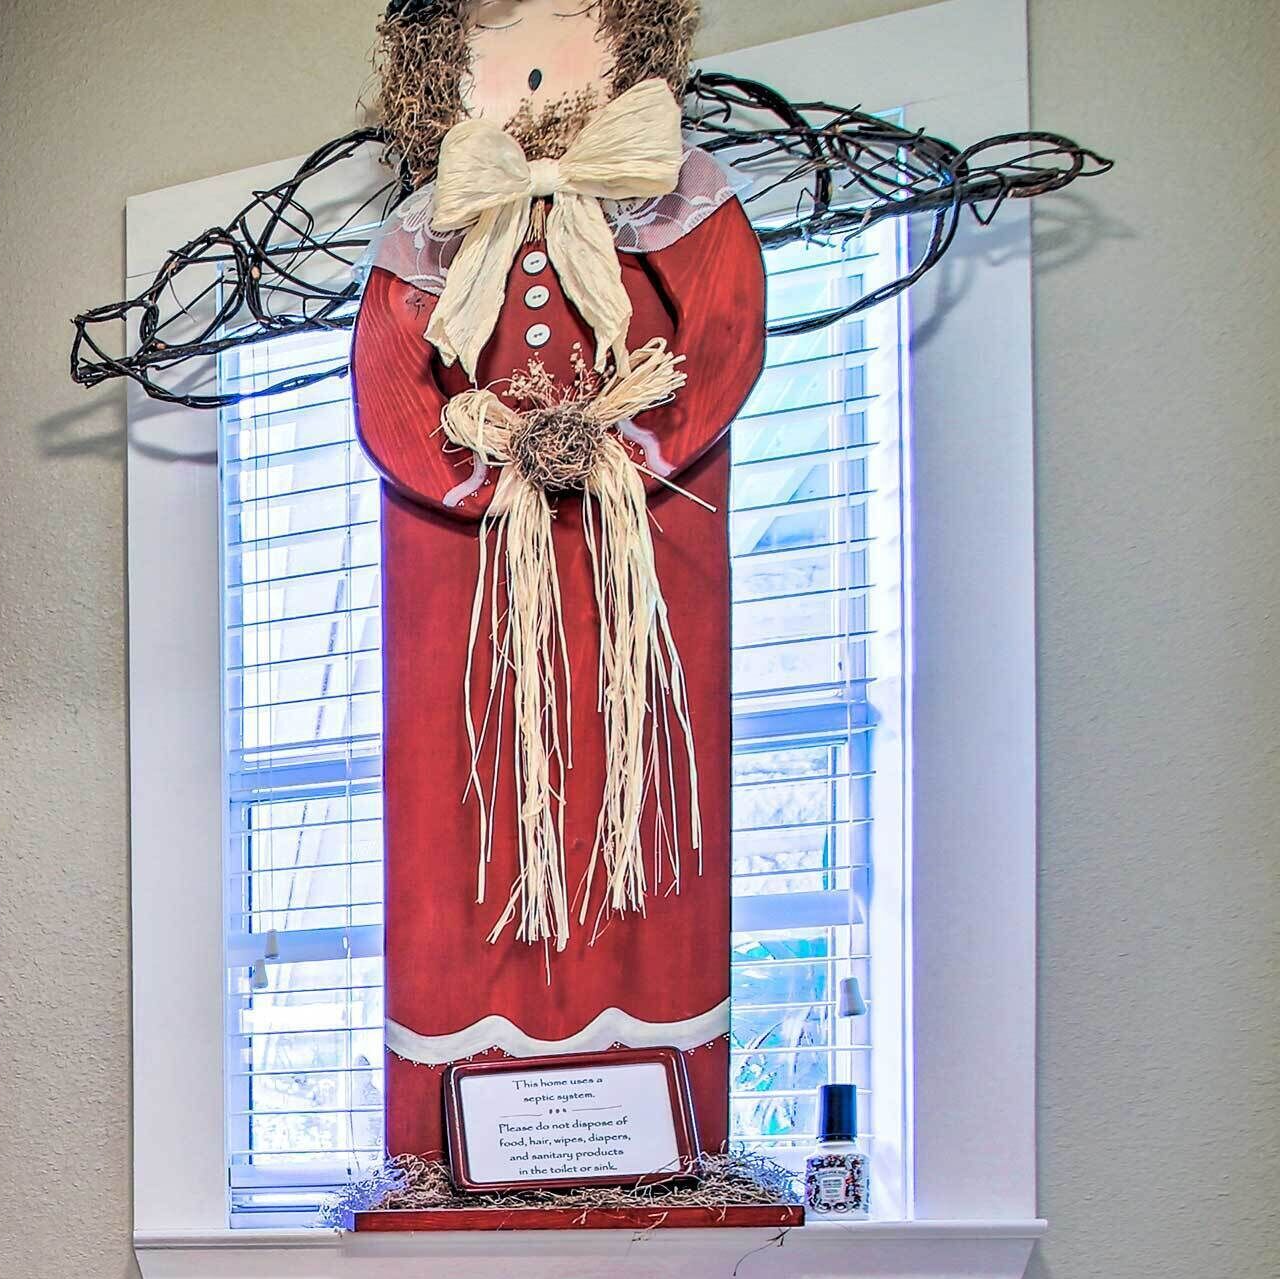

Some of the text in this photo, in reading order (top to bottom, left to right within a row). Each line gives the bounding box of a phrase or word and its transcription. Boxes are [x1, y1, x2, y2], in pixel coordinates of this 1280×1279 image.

[512, 1079, 538, 1090] This
[540, 1078, 567, 1087] home
[570, 1078, 594, 1086] uses
[523, 1092, 595, 1105] septic system.
[499, 1115, 628, 1134] Please do not dispose of
[500, 1133, 631, 1147] food, hair, wipes, diapers,
[510, 1147, 624, 1161] and sanitary products
[519, 1167, 528, 1175] in
[530, 1165, 547, 1175] the
[550, 1164, 577, 1174] toilet
